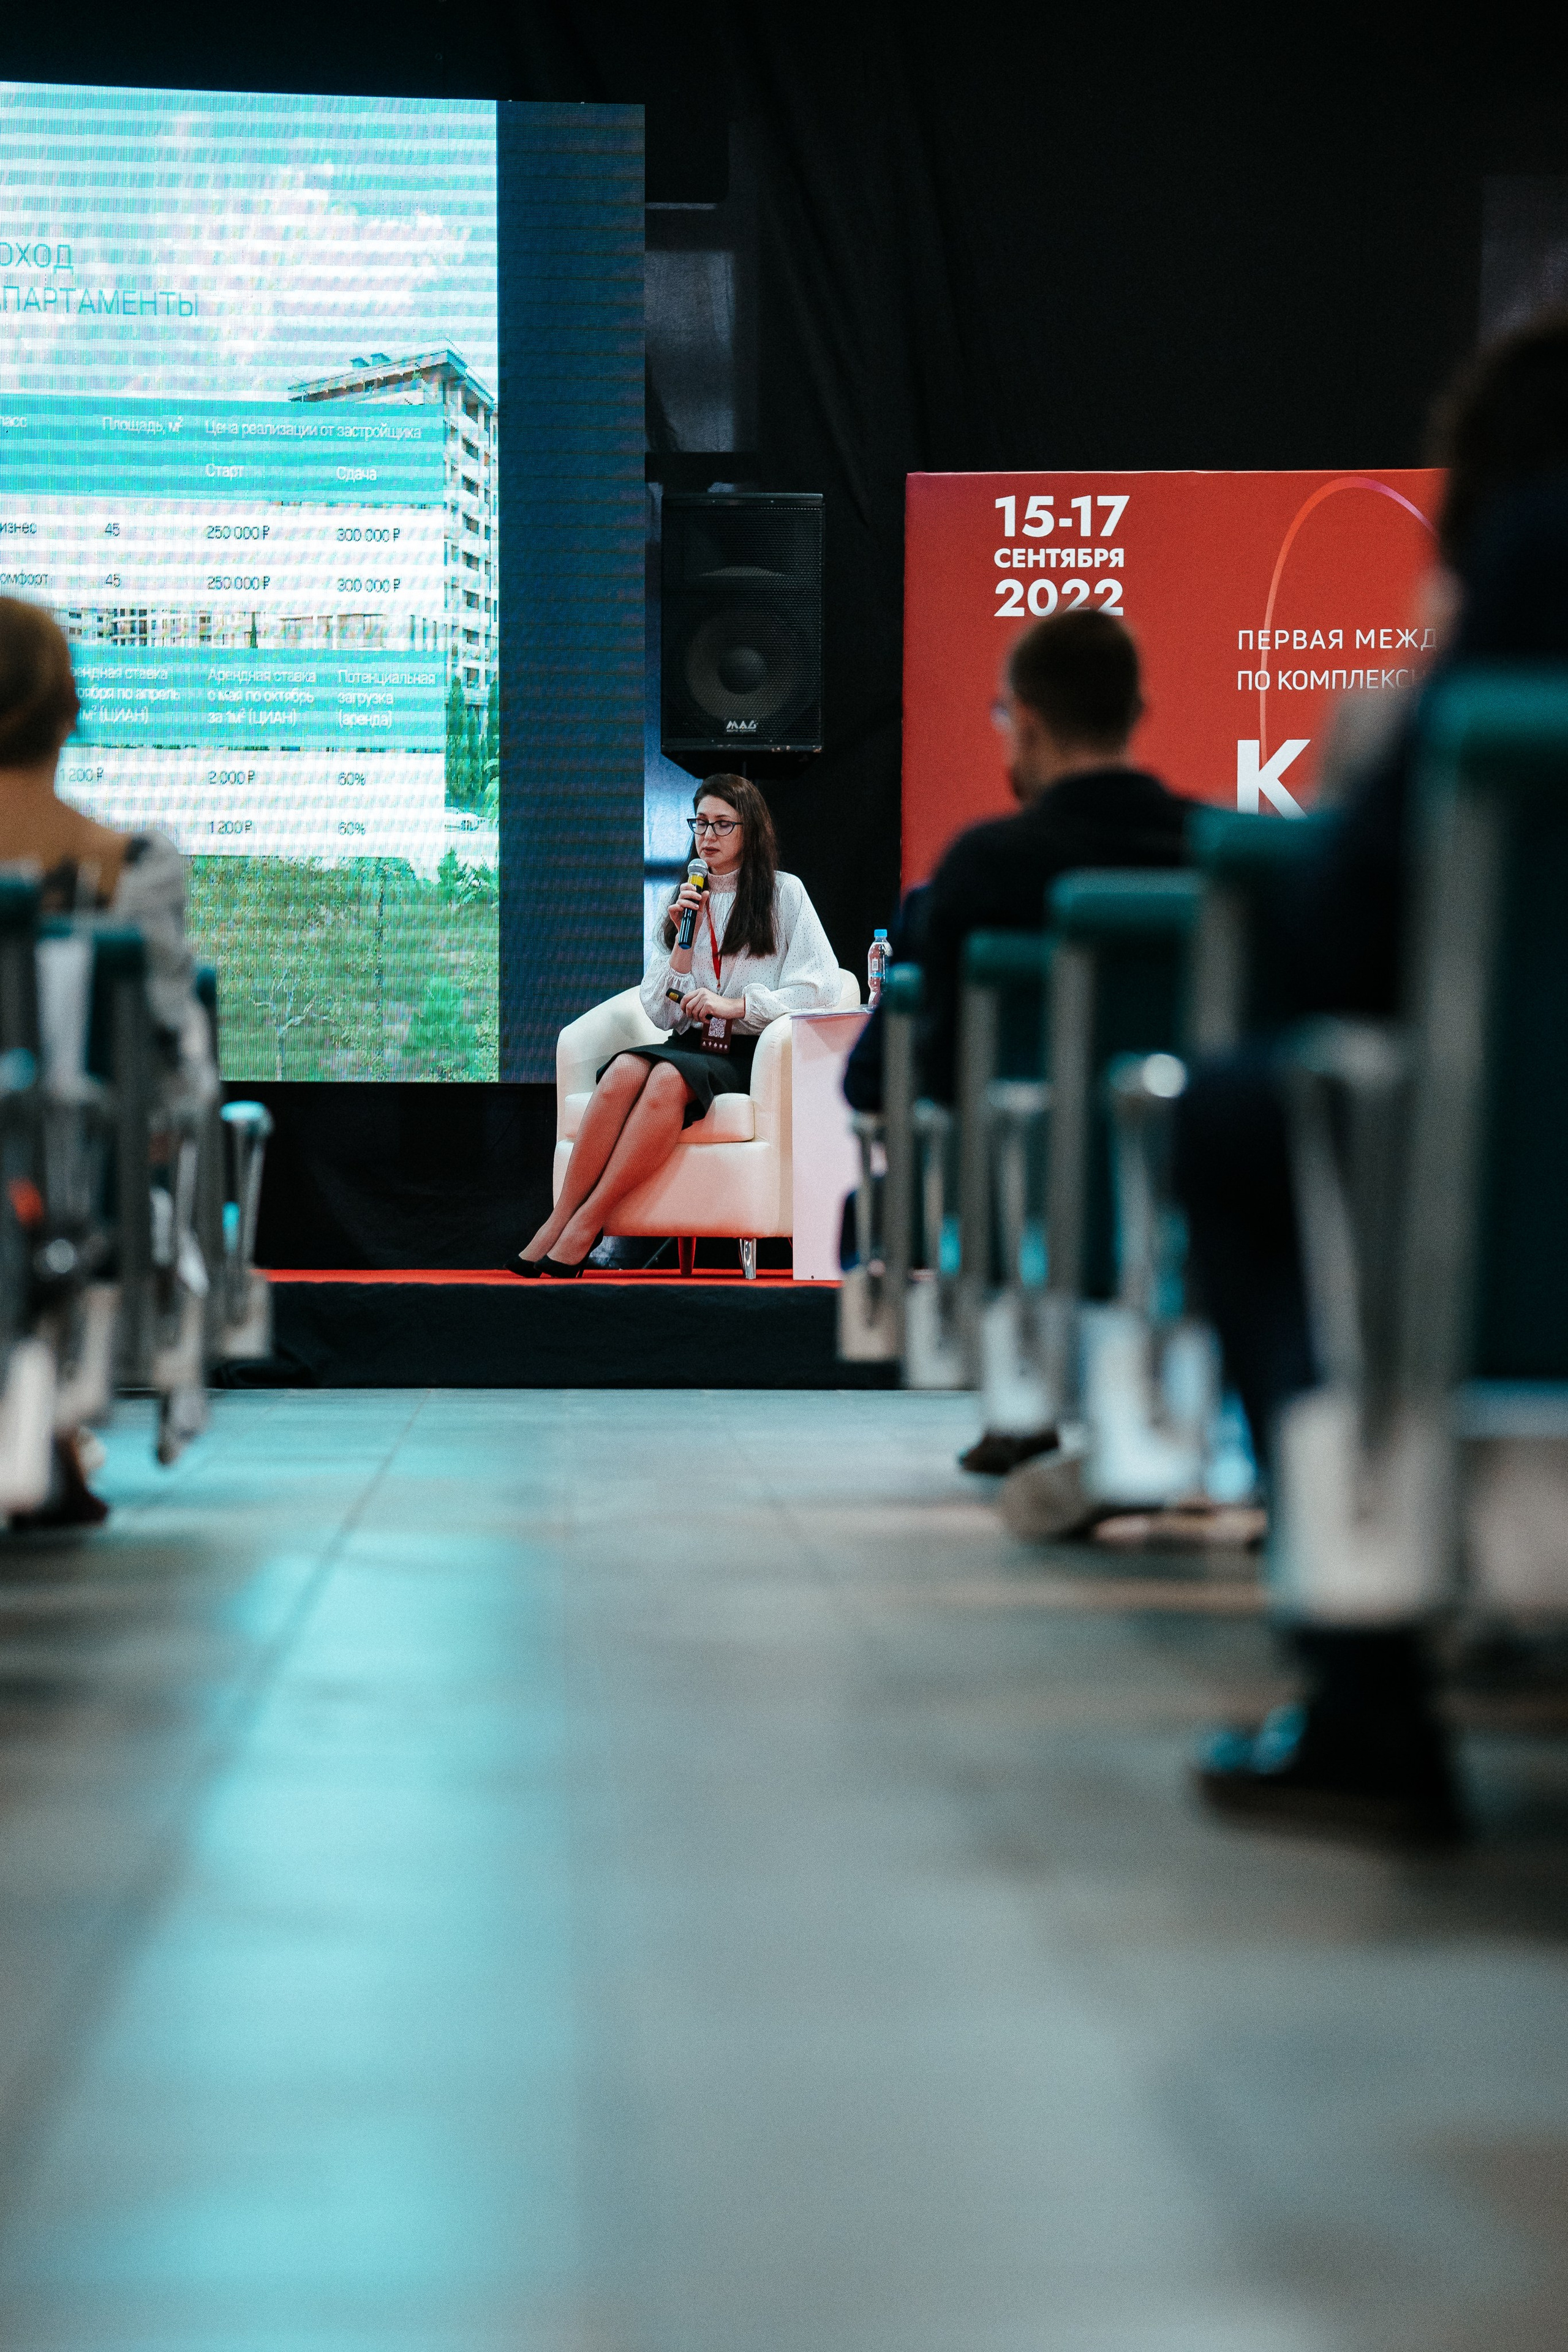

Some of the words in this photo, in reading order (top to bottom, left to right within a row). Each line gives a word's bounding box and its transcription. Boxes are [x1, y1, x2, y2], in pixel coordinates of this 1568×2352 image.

[0, 285, 198, 316] ПАРТАМЕНТЫ
[102, 417, 165, 435] Площадь,
[205, 420, 239, 436] Цена
[241, 423, 318, 439] реализации
[320, 426, 334, 437] от
[337, 423, 422, 442] застройщика
[205, 464, 244, 480] Старт
[336, 466, 377, 482] Сдача
[995, 495, 1130, 538] 15-17
[104, 522, 121, 537] 45
[993, 548, 1125, 568] СЕНТЯБРЯ
[105, 573, 121, 587] 45
[993, 578, 1124, 617] 2022
[1238, 629, 1343, 650] ПЕРВАЯ
[125, 668, 168, 680] ставка
[208, 668, 271, 685] Арендная
[274, 671, 315, 682] ставка
[338, 669, 435, 686] Потенциальная
[1237, 670, 1270, 691] ПО
[117, 688, 133, 699] по
[135, 689, 180, 703] апрель
[207, 691, 216, 701] с
[217, 690, 243, 701] мая
[246, 691, 262, 702] по
[264, 689, 314, 704] октябрь
[337, 692, 393, 706] загрузка
[99, 706, 149, 725] (ЦИАН)
[208, 712, 222, 723] за
[248, 708, 297, 726] (ЦИАН)
[337, 711, 393, 729] (аренда)
[726, 720, 759, 729] MAG
